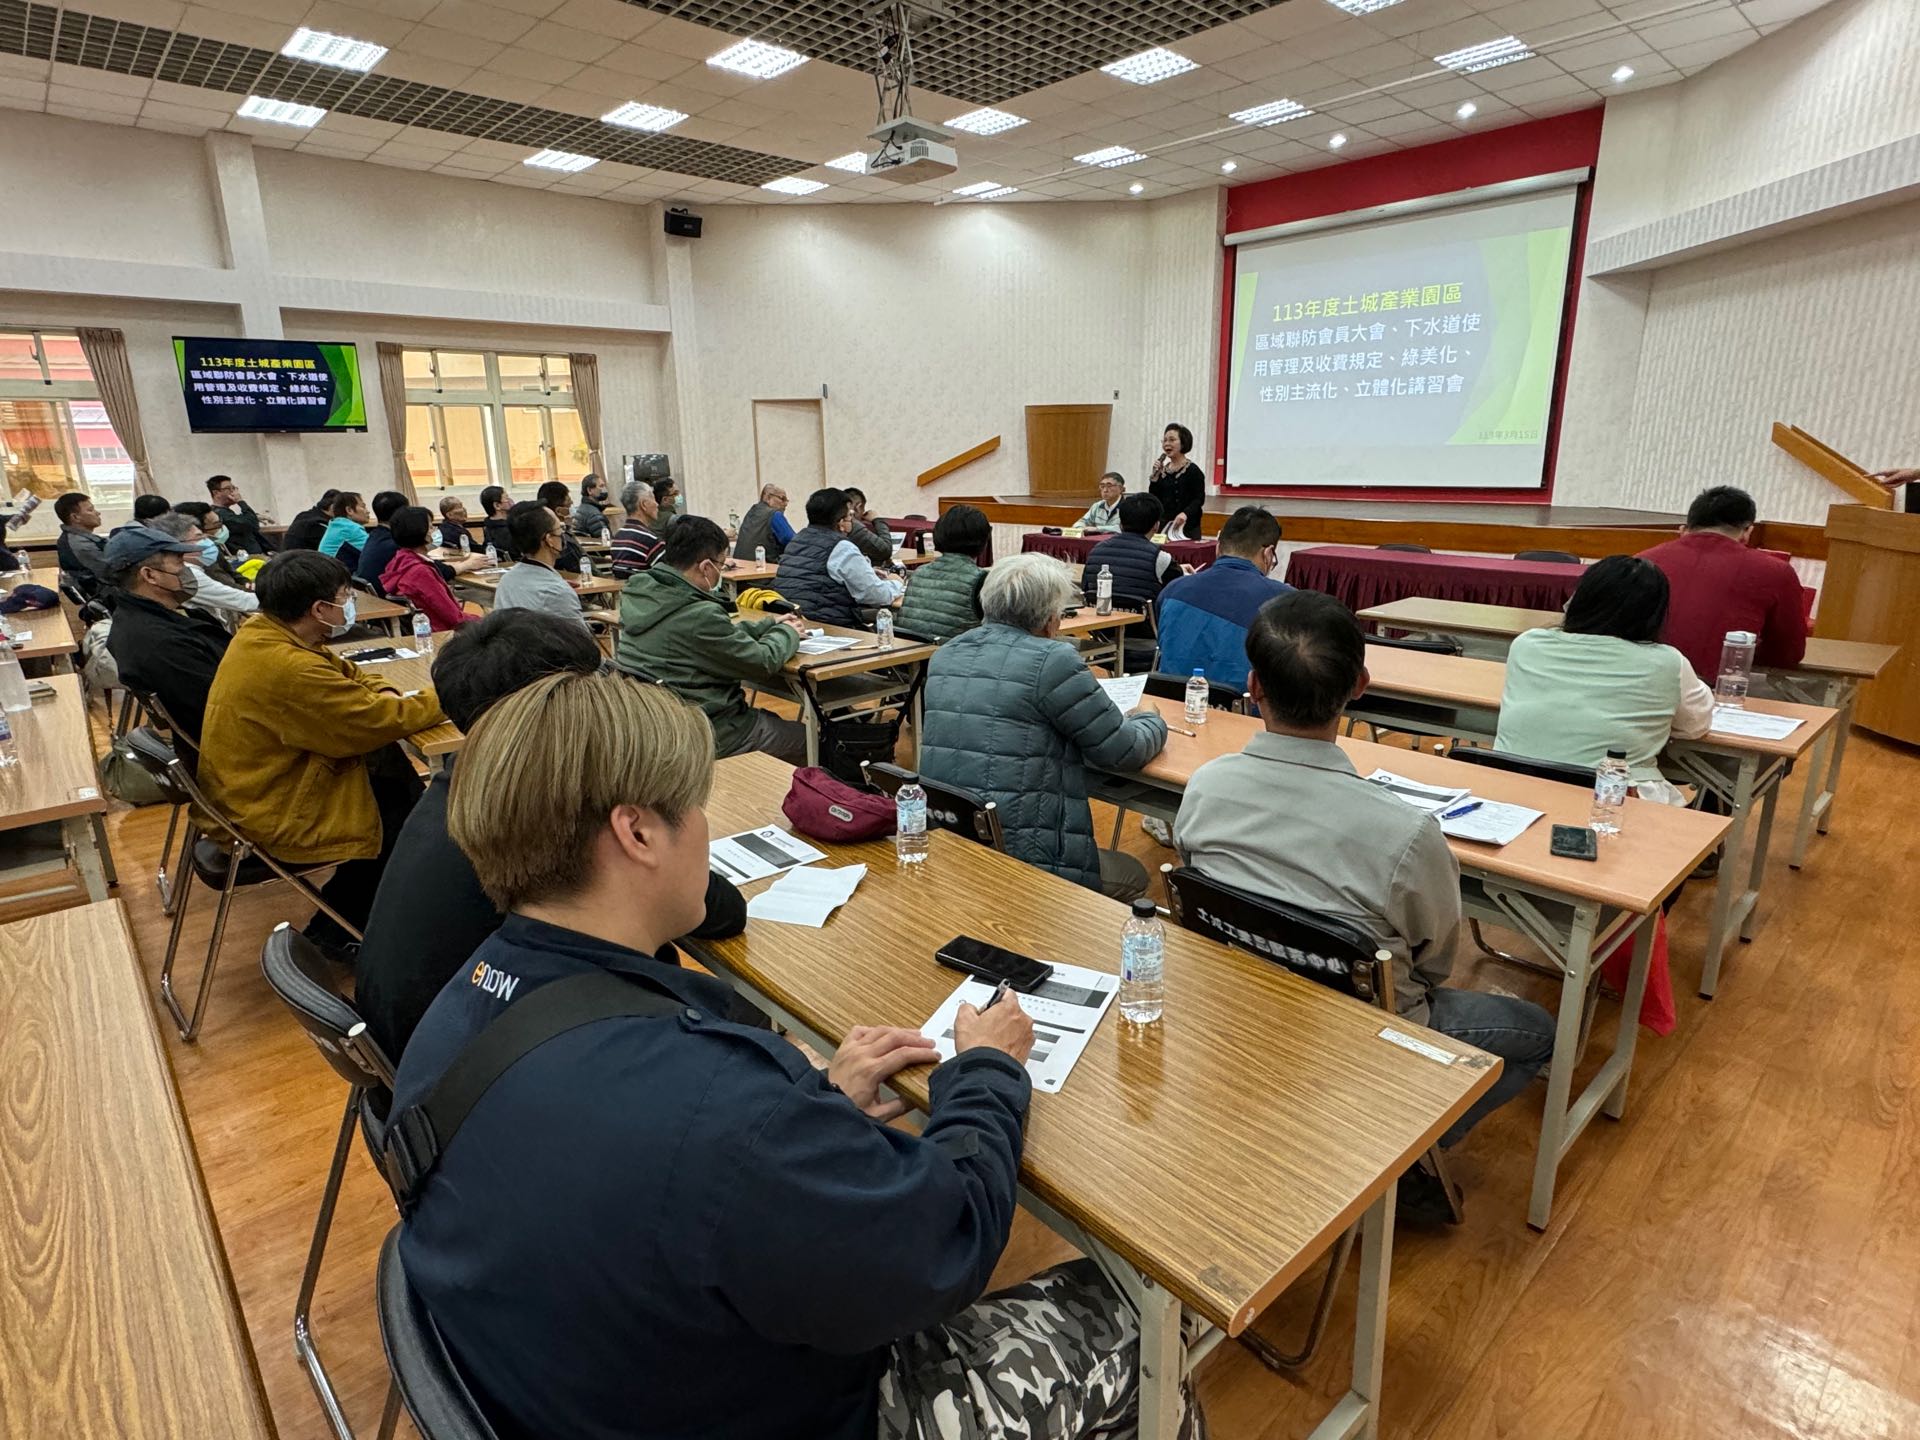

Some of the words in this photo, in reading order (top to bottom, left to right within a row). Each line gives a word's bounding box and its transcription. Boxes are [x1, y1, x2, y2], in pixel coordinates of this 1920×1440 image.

[1272, 282, 1464, 322] 113年度土城產業園區
[1254, 313, 1482, 351] 區域聯防會員大會、下水道使
[1253, 346, 1473, 377] 用管理及收費規定、綠美化、
[1259, 374, 1465, 403] 性別主流化、立體化講習會
